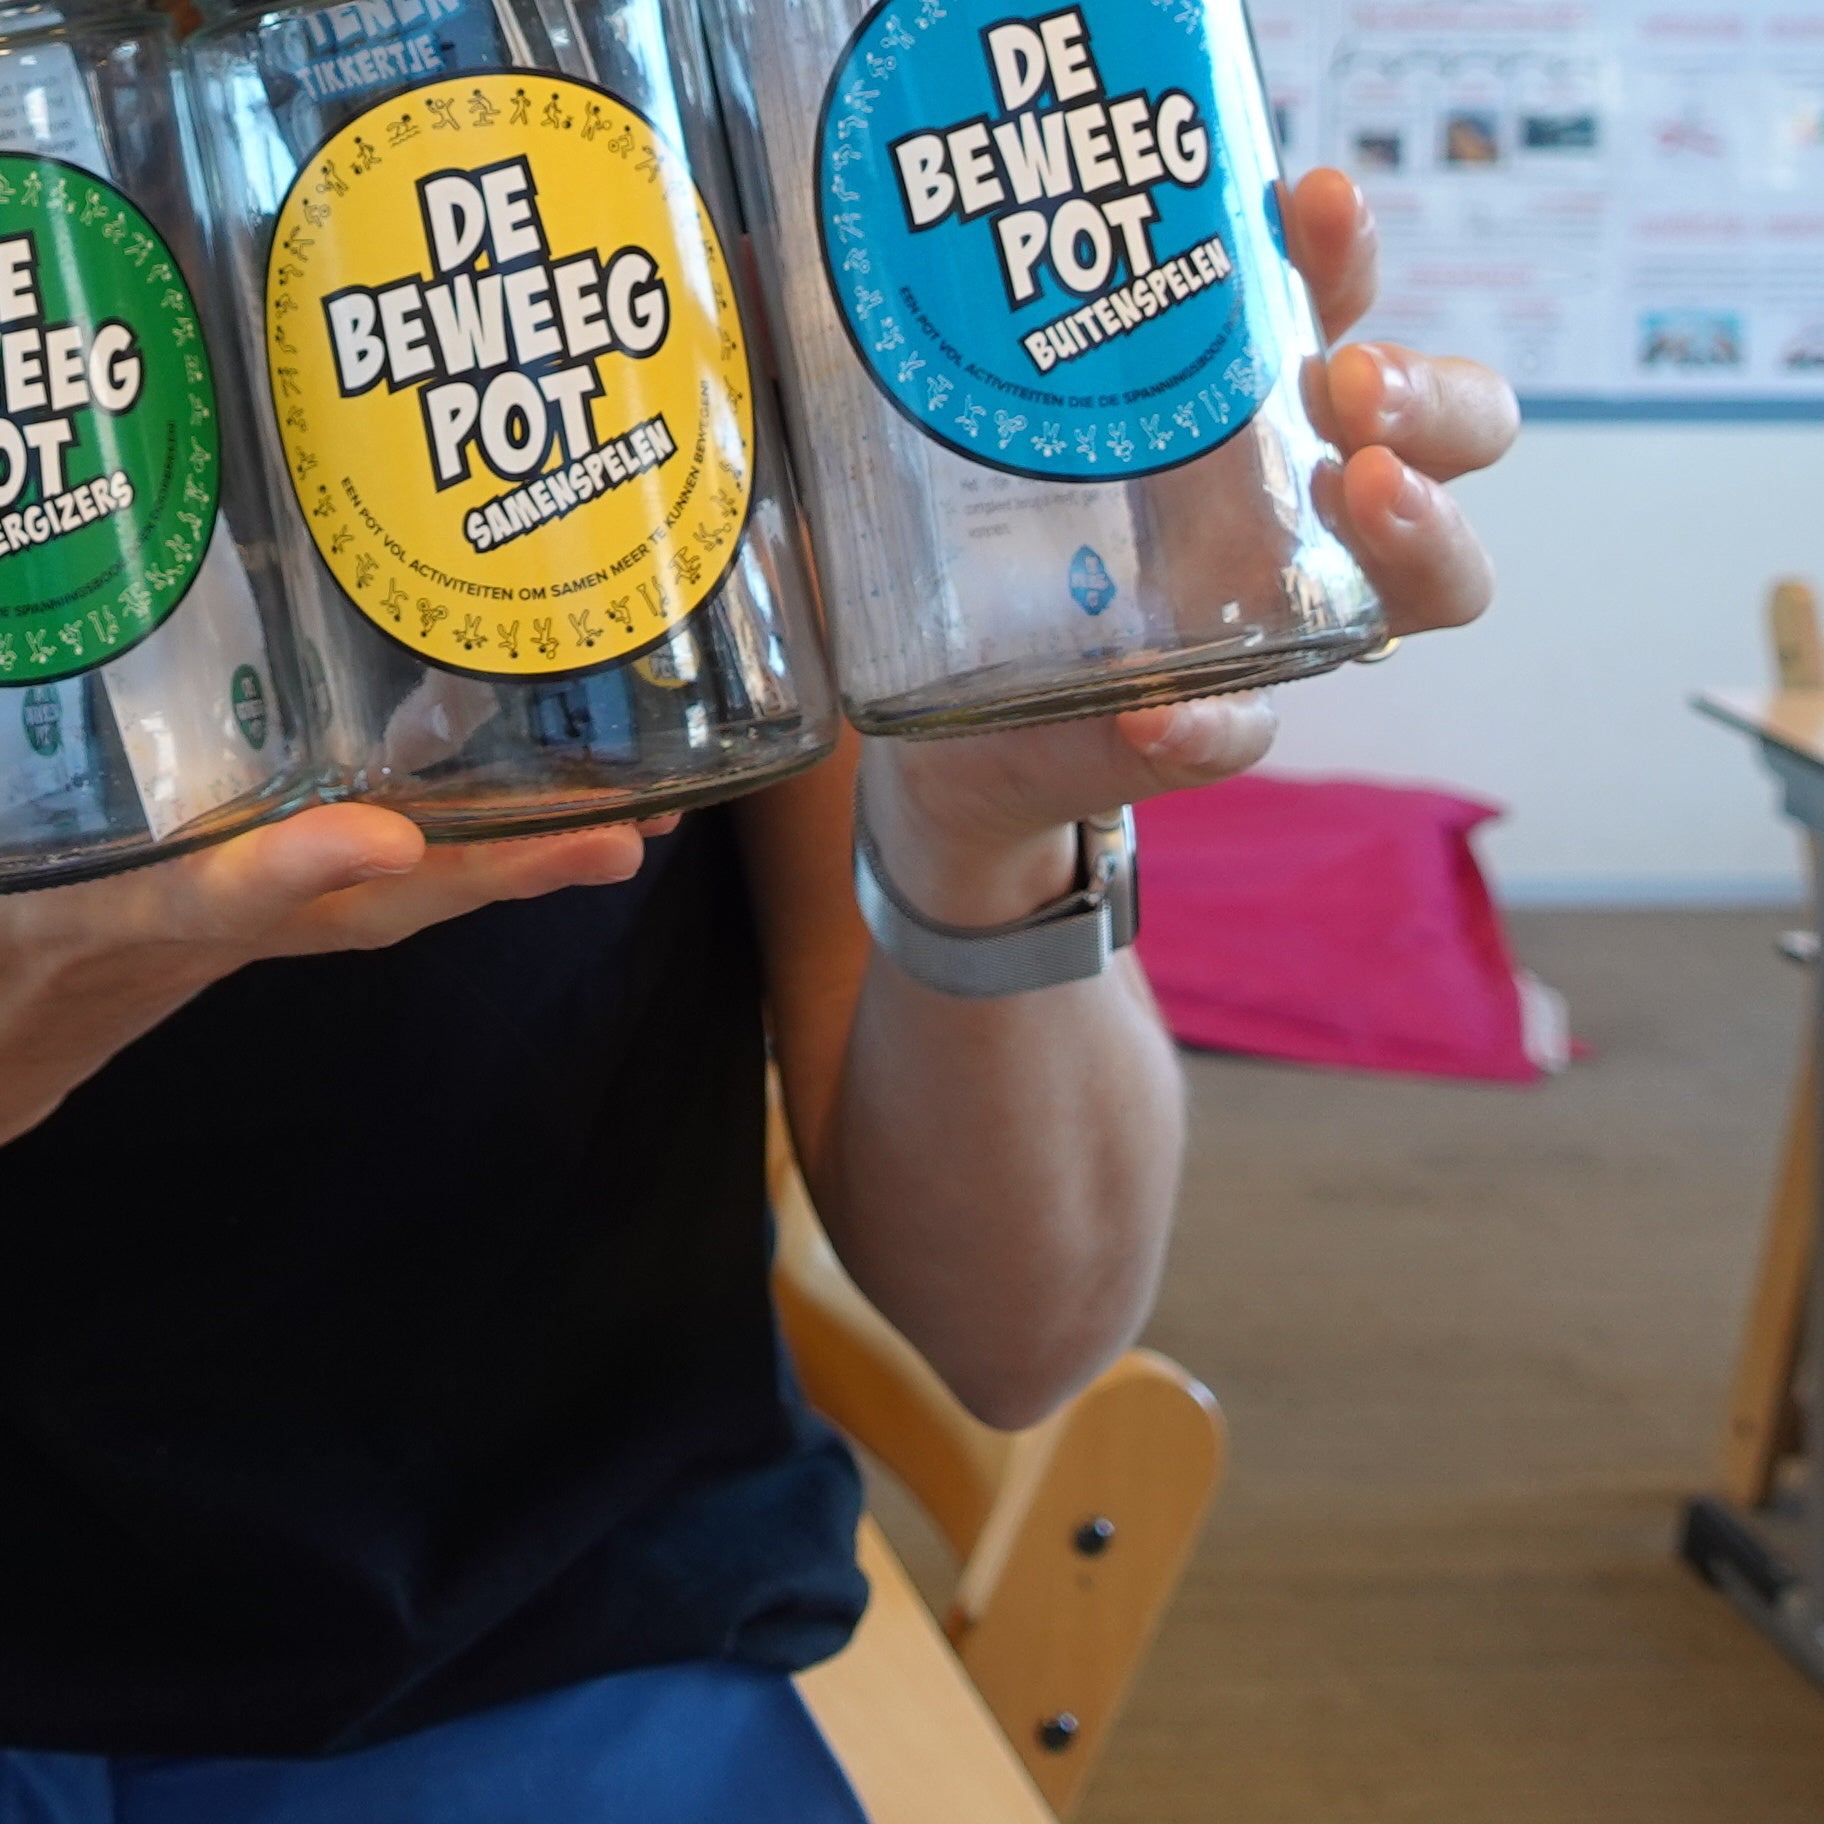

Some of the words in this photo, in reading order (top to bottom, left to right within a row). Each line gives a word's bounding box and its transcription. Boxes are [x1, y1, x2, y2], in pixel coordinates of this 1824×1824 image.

[294, 33, 442, 102] TIKKERTJE
[985, 9, 1099, 113] DE
[421, 162, 543, 275] DE
[892, 91, 1210, 228] BEWEEG
[994, 189, 1156, 304] POT
[1022, 236, 1233, 374] BUITENSPELEN
[325, 251, 668, 392] BEWEEG
[423, 363, 598, 483] POT
[465, 417, 677, 552] SAMENSPELEN
[340, 475, 362, 509] EEN
[358, 508, 383, 537] POT
[382, 533, 408, 564] VOL
[407, 559, 514, 601] ACTIVITEITEN
[517, 586, 547, 601] OM
[550, 567, 609, 596] SAMEN
[609, 542, 651, 577] MEER
[647, 526, 668, 546] TE
[663, 464, 701, 531] KUNNEN
